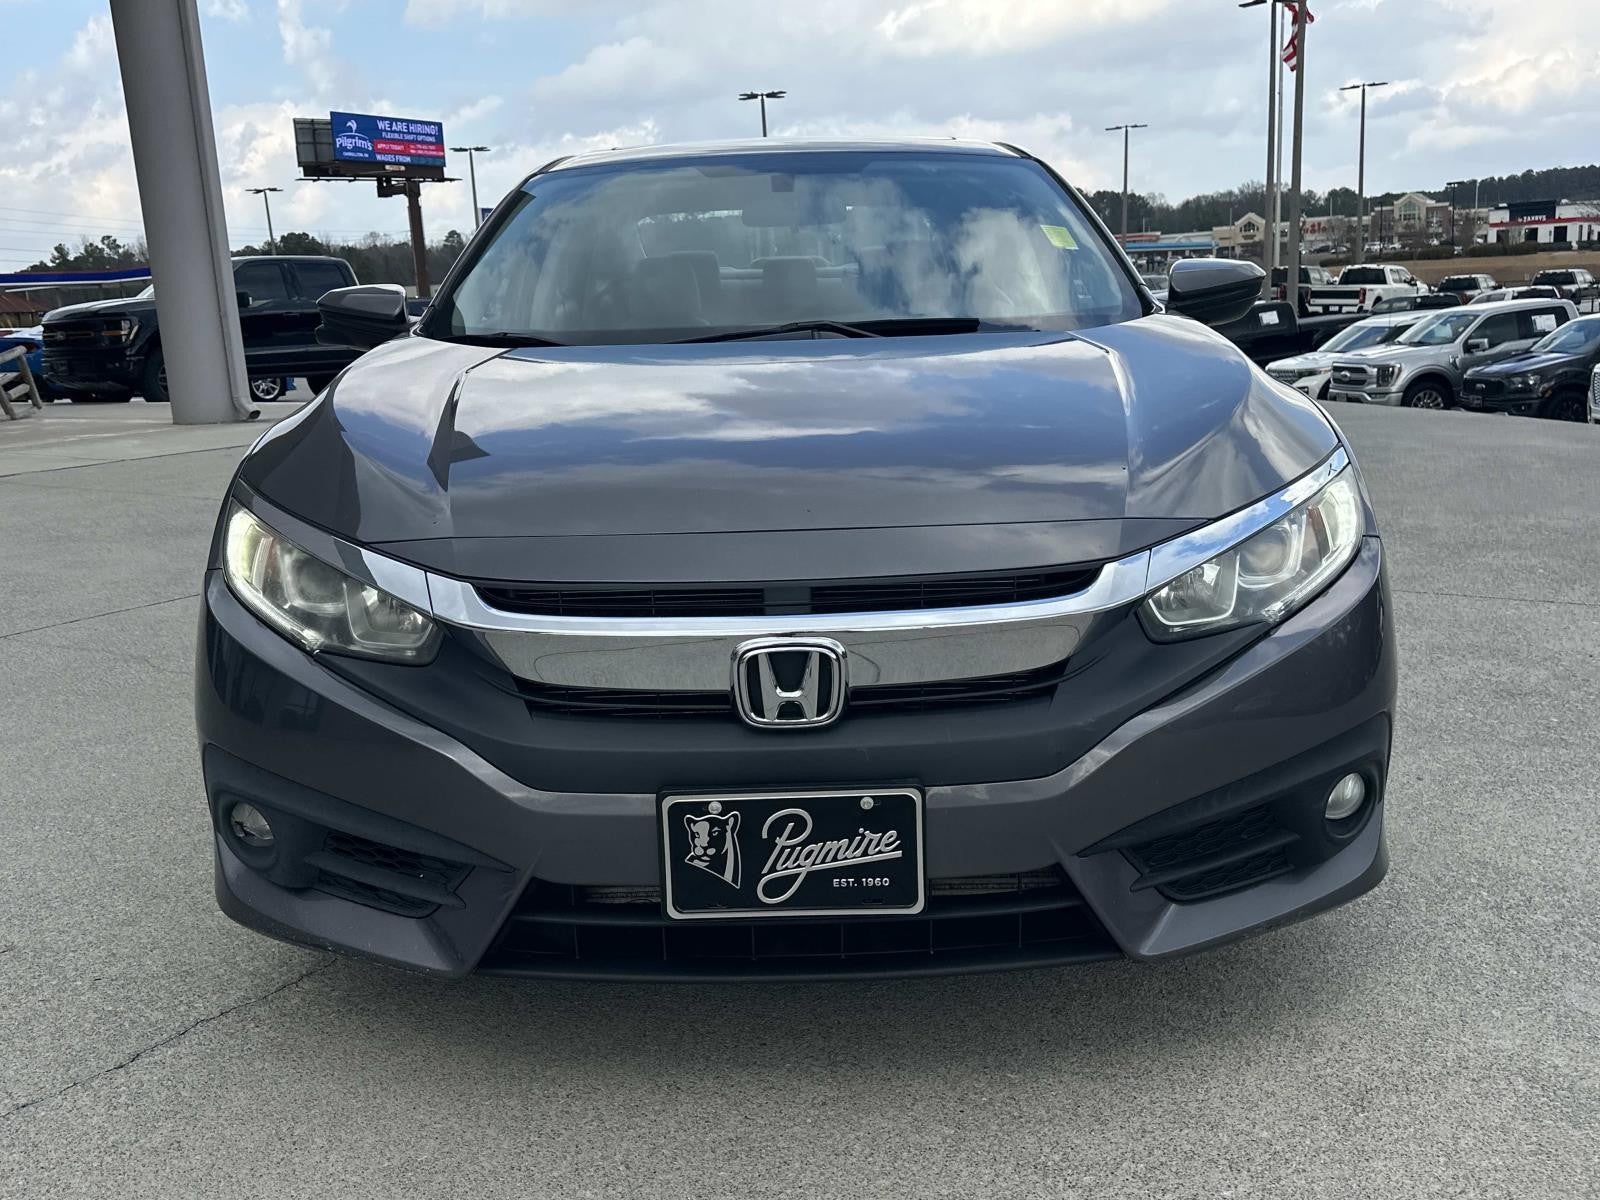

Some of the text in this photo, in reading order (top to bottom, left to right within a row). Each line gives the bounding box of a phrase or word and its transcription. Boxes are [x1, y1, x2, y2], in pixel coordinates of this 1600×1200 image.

[377, 119, 438, 135] WE ARE HIRING!
[336, 136, 373, 151] Pilgrim's
[757, 808, 903, 904] Pugmire
[833, 877, 890, 887] EST. 1960
